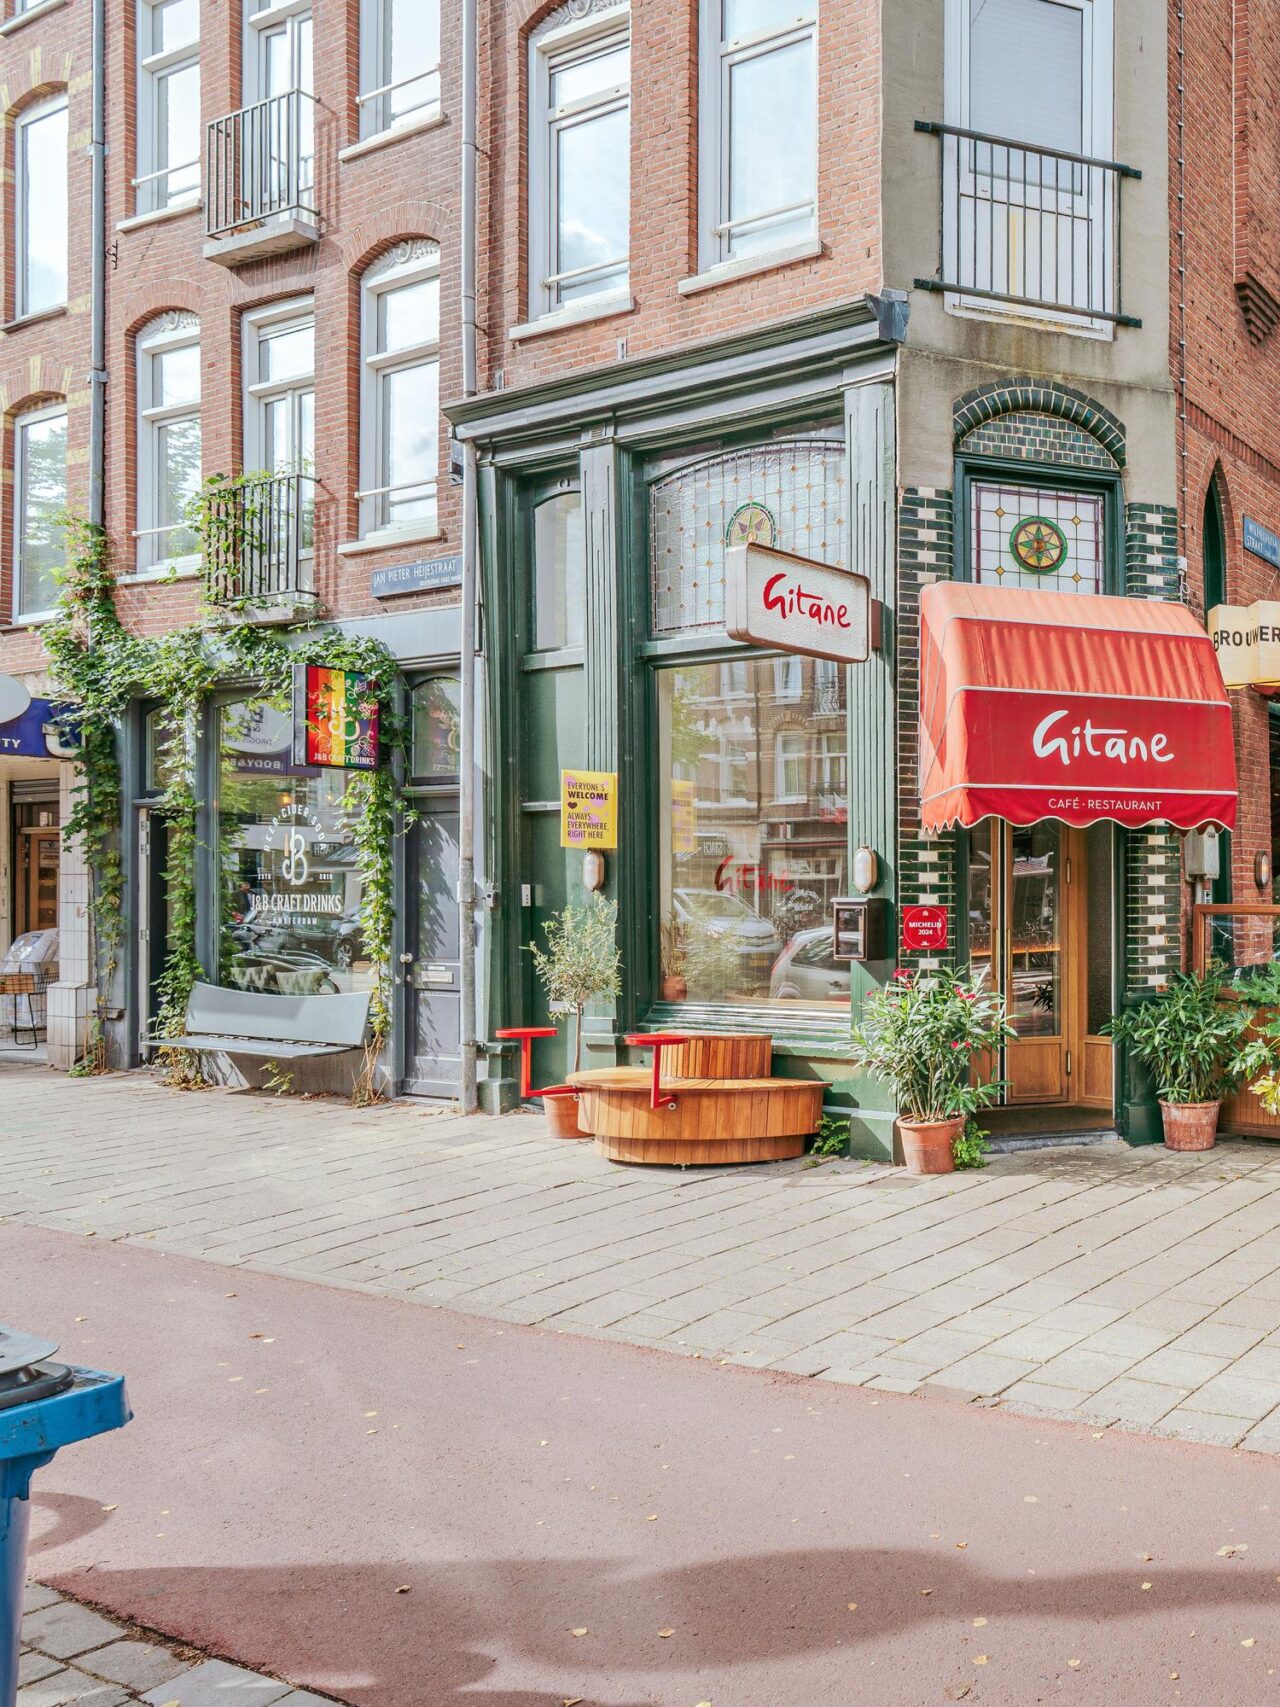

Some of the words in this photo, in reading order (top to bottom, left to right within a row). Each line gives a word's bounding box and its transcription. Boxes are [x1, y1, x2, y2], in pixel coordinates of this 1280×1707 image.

[373, 568, 386, 587] JAN
[388, 568, 410, 582] PIETER
[763, 573, 851, 628] Gitane
[1033, 709, 1174, 766] Gitane
[567, 781, 605, 791] EVERYONE'S
[567, 790, 609, 801] WELCOME
[1049, 797, 1080, 809] CAFÉ
[1087, 799, 1162, 811] RESTAURANT
[281, 804, 310, 818] CIDER
[567, 812, 592, 821] ALWAYS
[567, 820, 610, 832] EVERYWHERE,
[567, 829, 586, 839] RIGHT
[587, 831, 604, 840] HERE
[250, 894, 270, 912] J&B
[271, 894, 302, 912] CRAFT
[303, 894, 342, 912] DRINKS
[908, 921, 942, 929] MICHELIN
